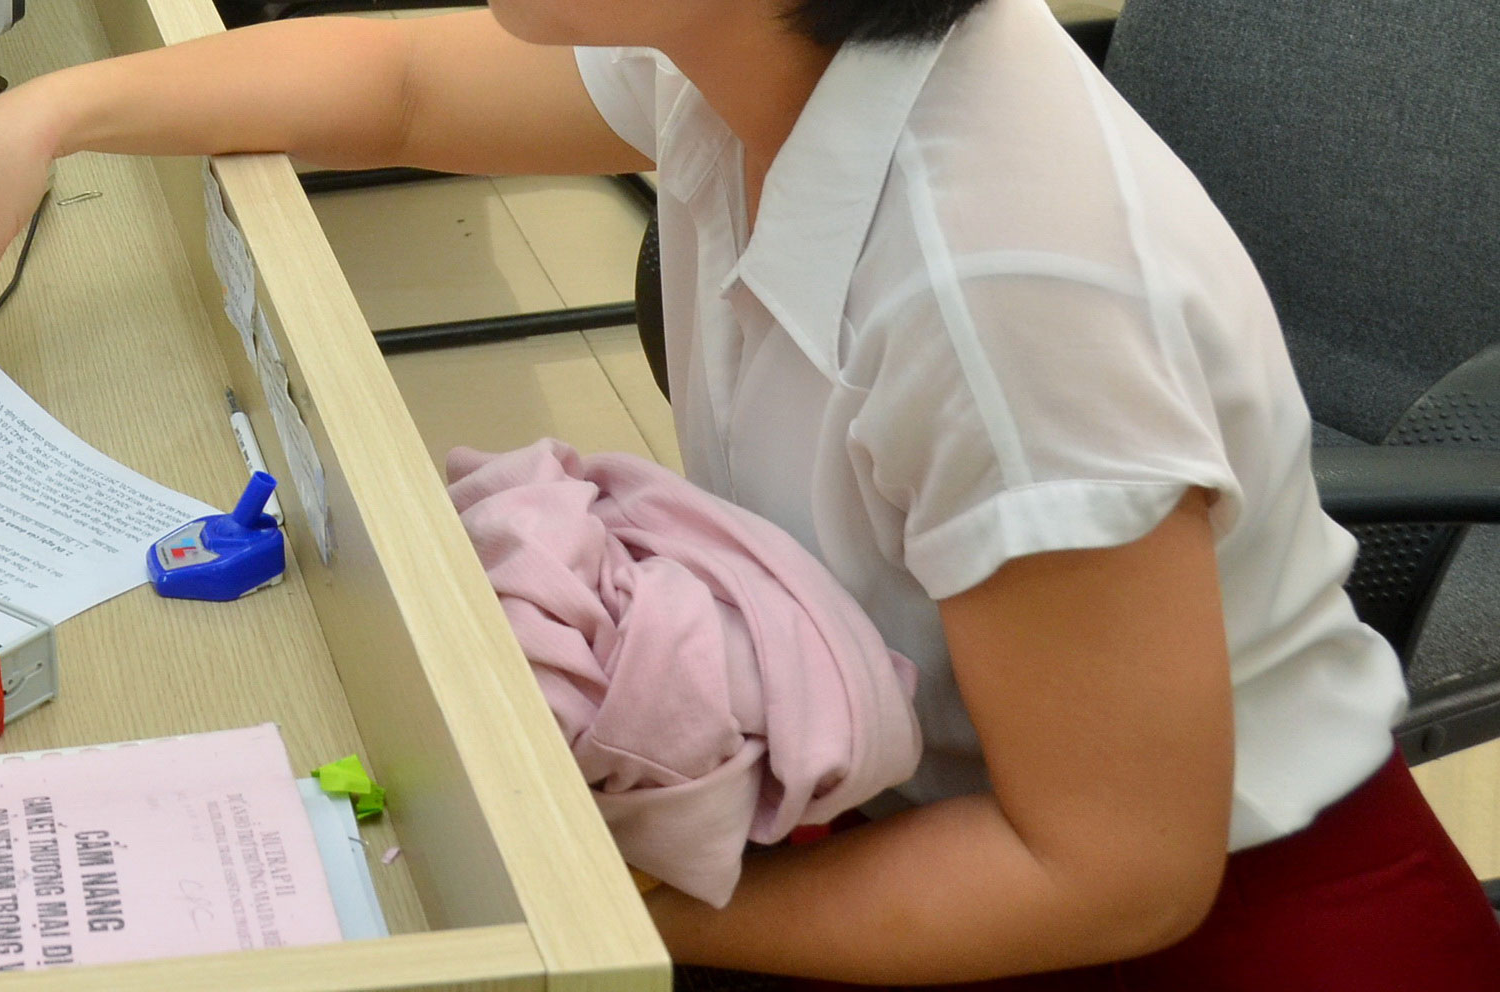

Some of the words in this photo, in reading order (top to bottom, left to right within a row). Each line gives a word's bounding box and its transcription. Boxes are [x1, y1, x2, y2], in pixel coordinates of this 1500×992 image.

[29, 837, 64, 896] THƯƠNG
[31, 901, 70, 937] MẠI
[80, 872, 124, 932] NANG
[36, 944, 73, 966] DỊ
